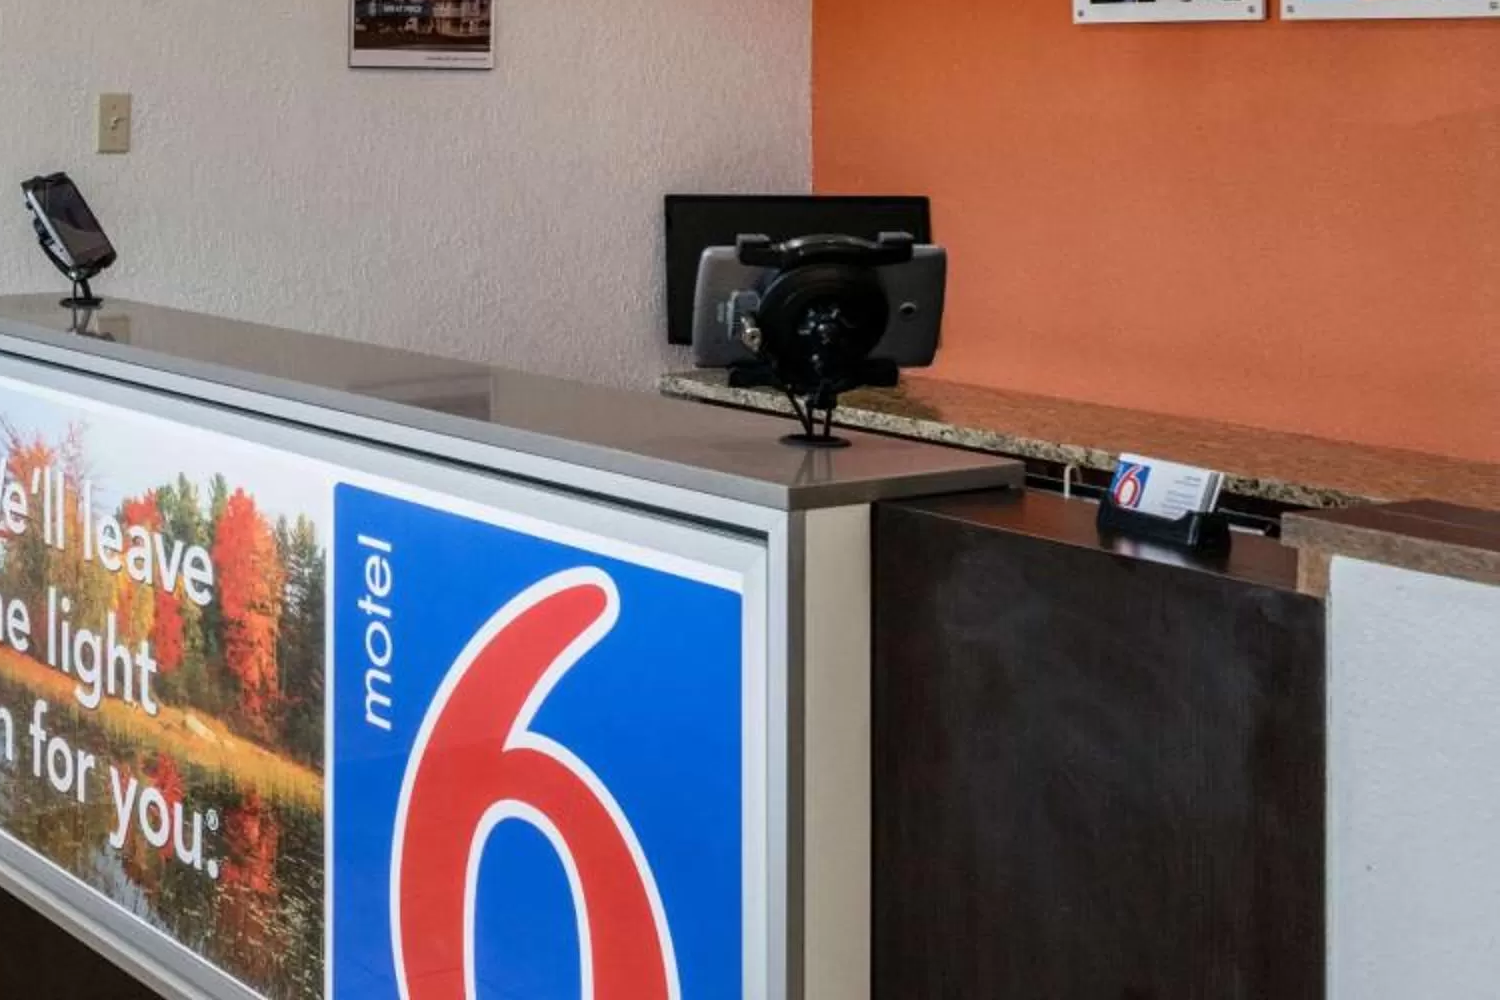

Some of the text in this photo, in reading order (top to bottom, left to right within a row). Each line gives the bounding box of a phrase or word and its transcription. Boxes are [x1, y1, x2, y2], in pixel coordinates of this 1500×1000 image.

[81, 479, 214, 606] leave
[48, 585, 157, 716] light
[356, 534, 393, 731] motel
[29, 699, 95, 803] for
[389, 565, 682, 1000] 6
